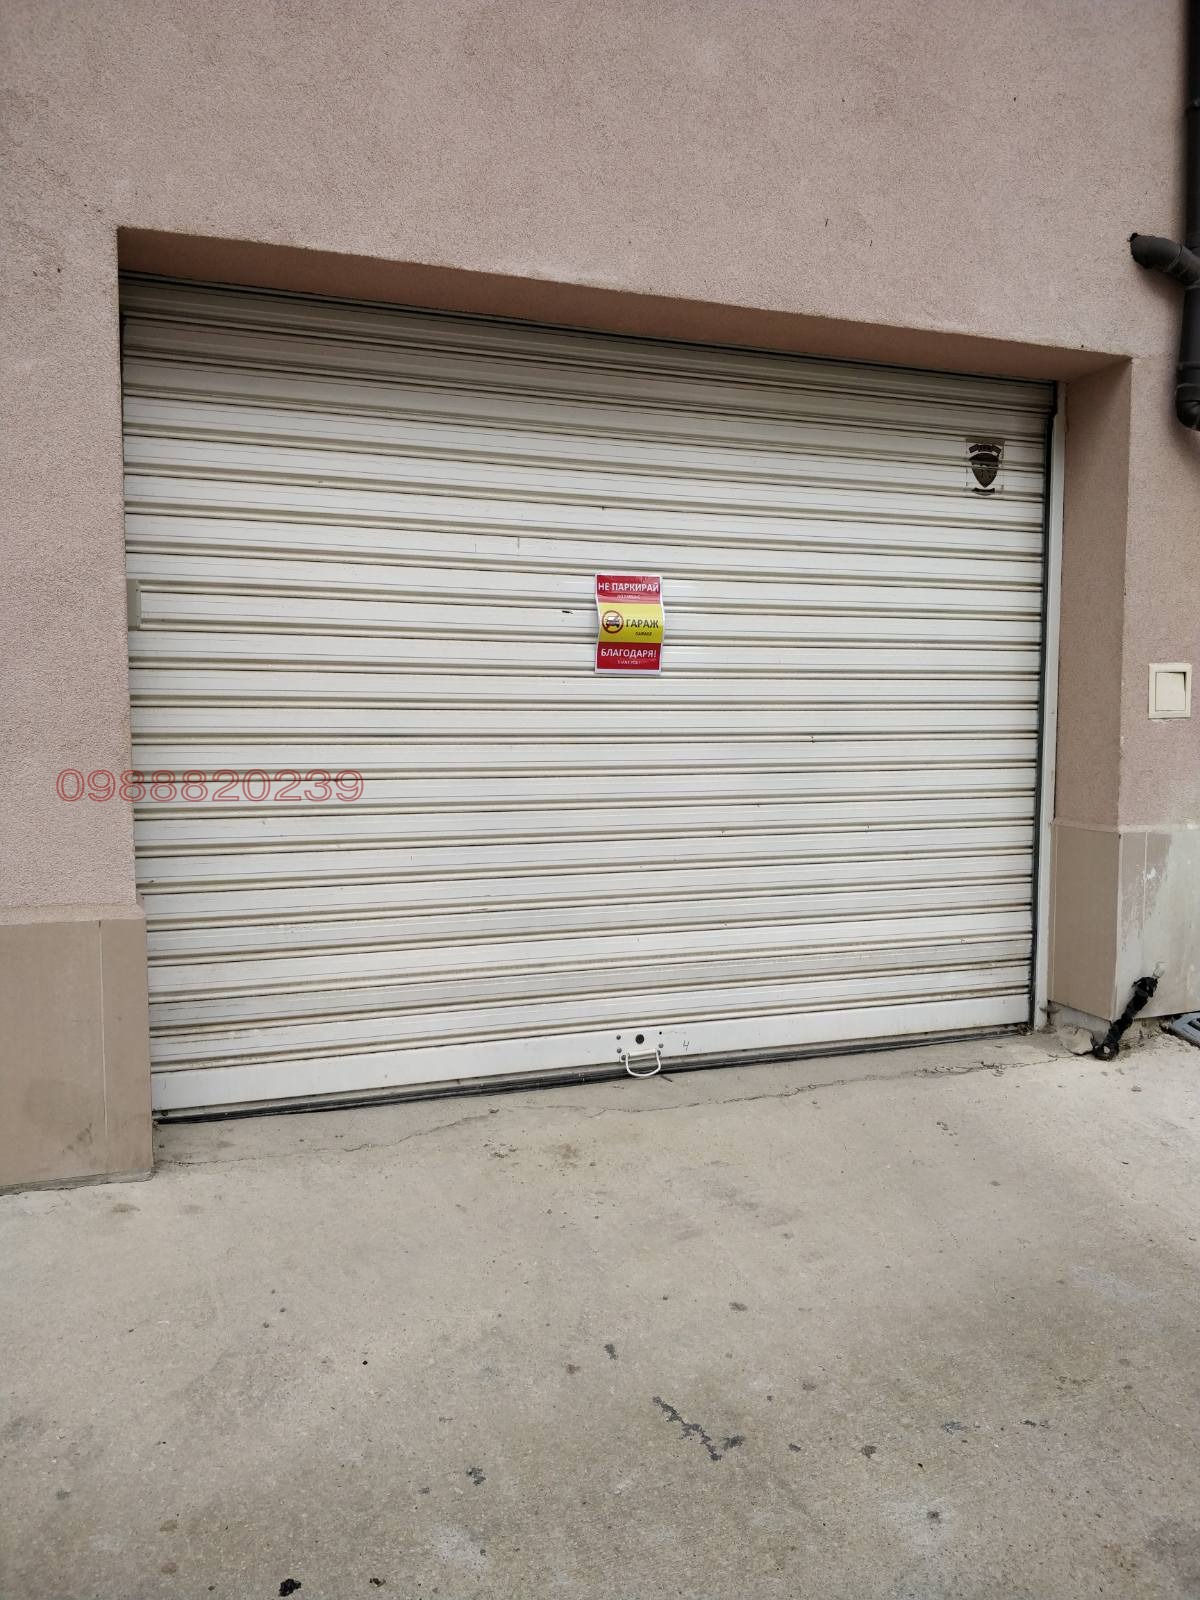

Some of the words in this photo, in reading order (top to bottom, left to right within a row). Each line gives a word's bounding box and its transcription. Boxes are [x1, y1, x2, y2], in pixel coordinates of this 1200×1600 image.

[598, 582, 610, 591] НЕ
[611, 582, 660, 592] ПАРКИРАЙ
[625, 619, 659, 628] ГАРАЖ
[601, 648, 657, 658] БЛАГОДАРЯ!
